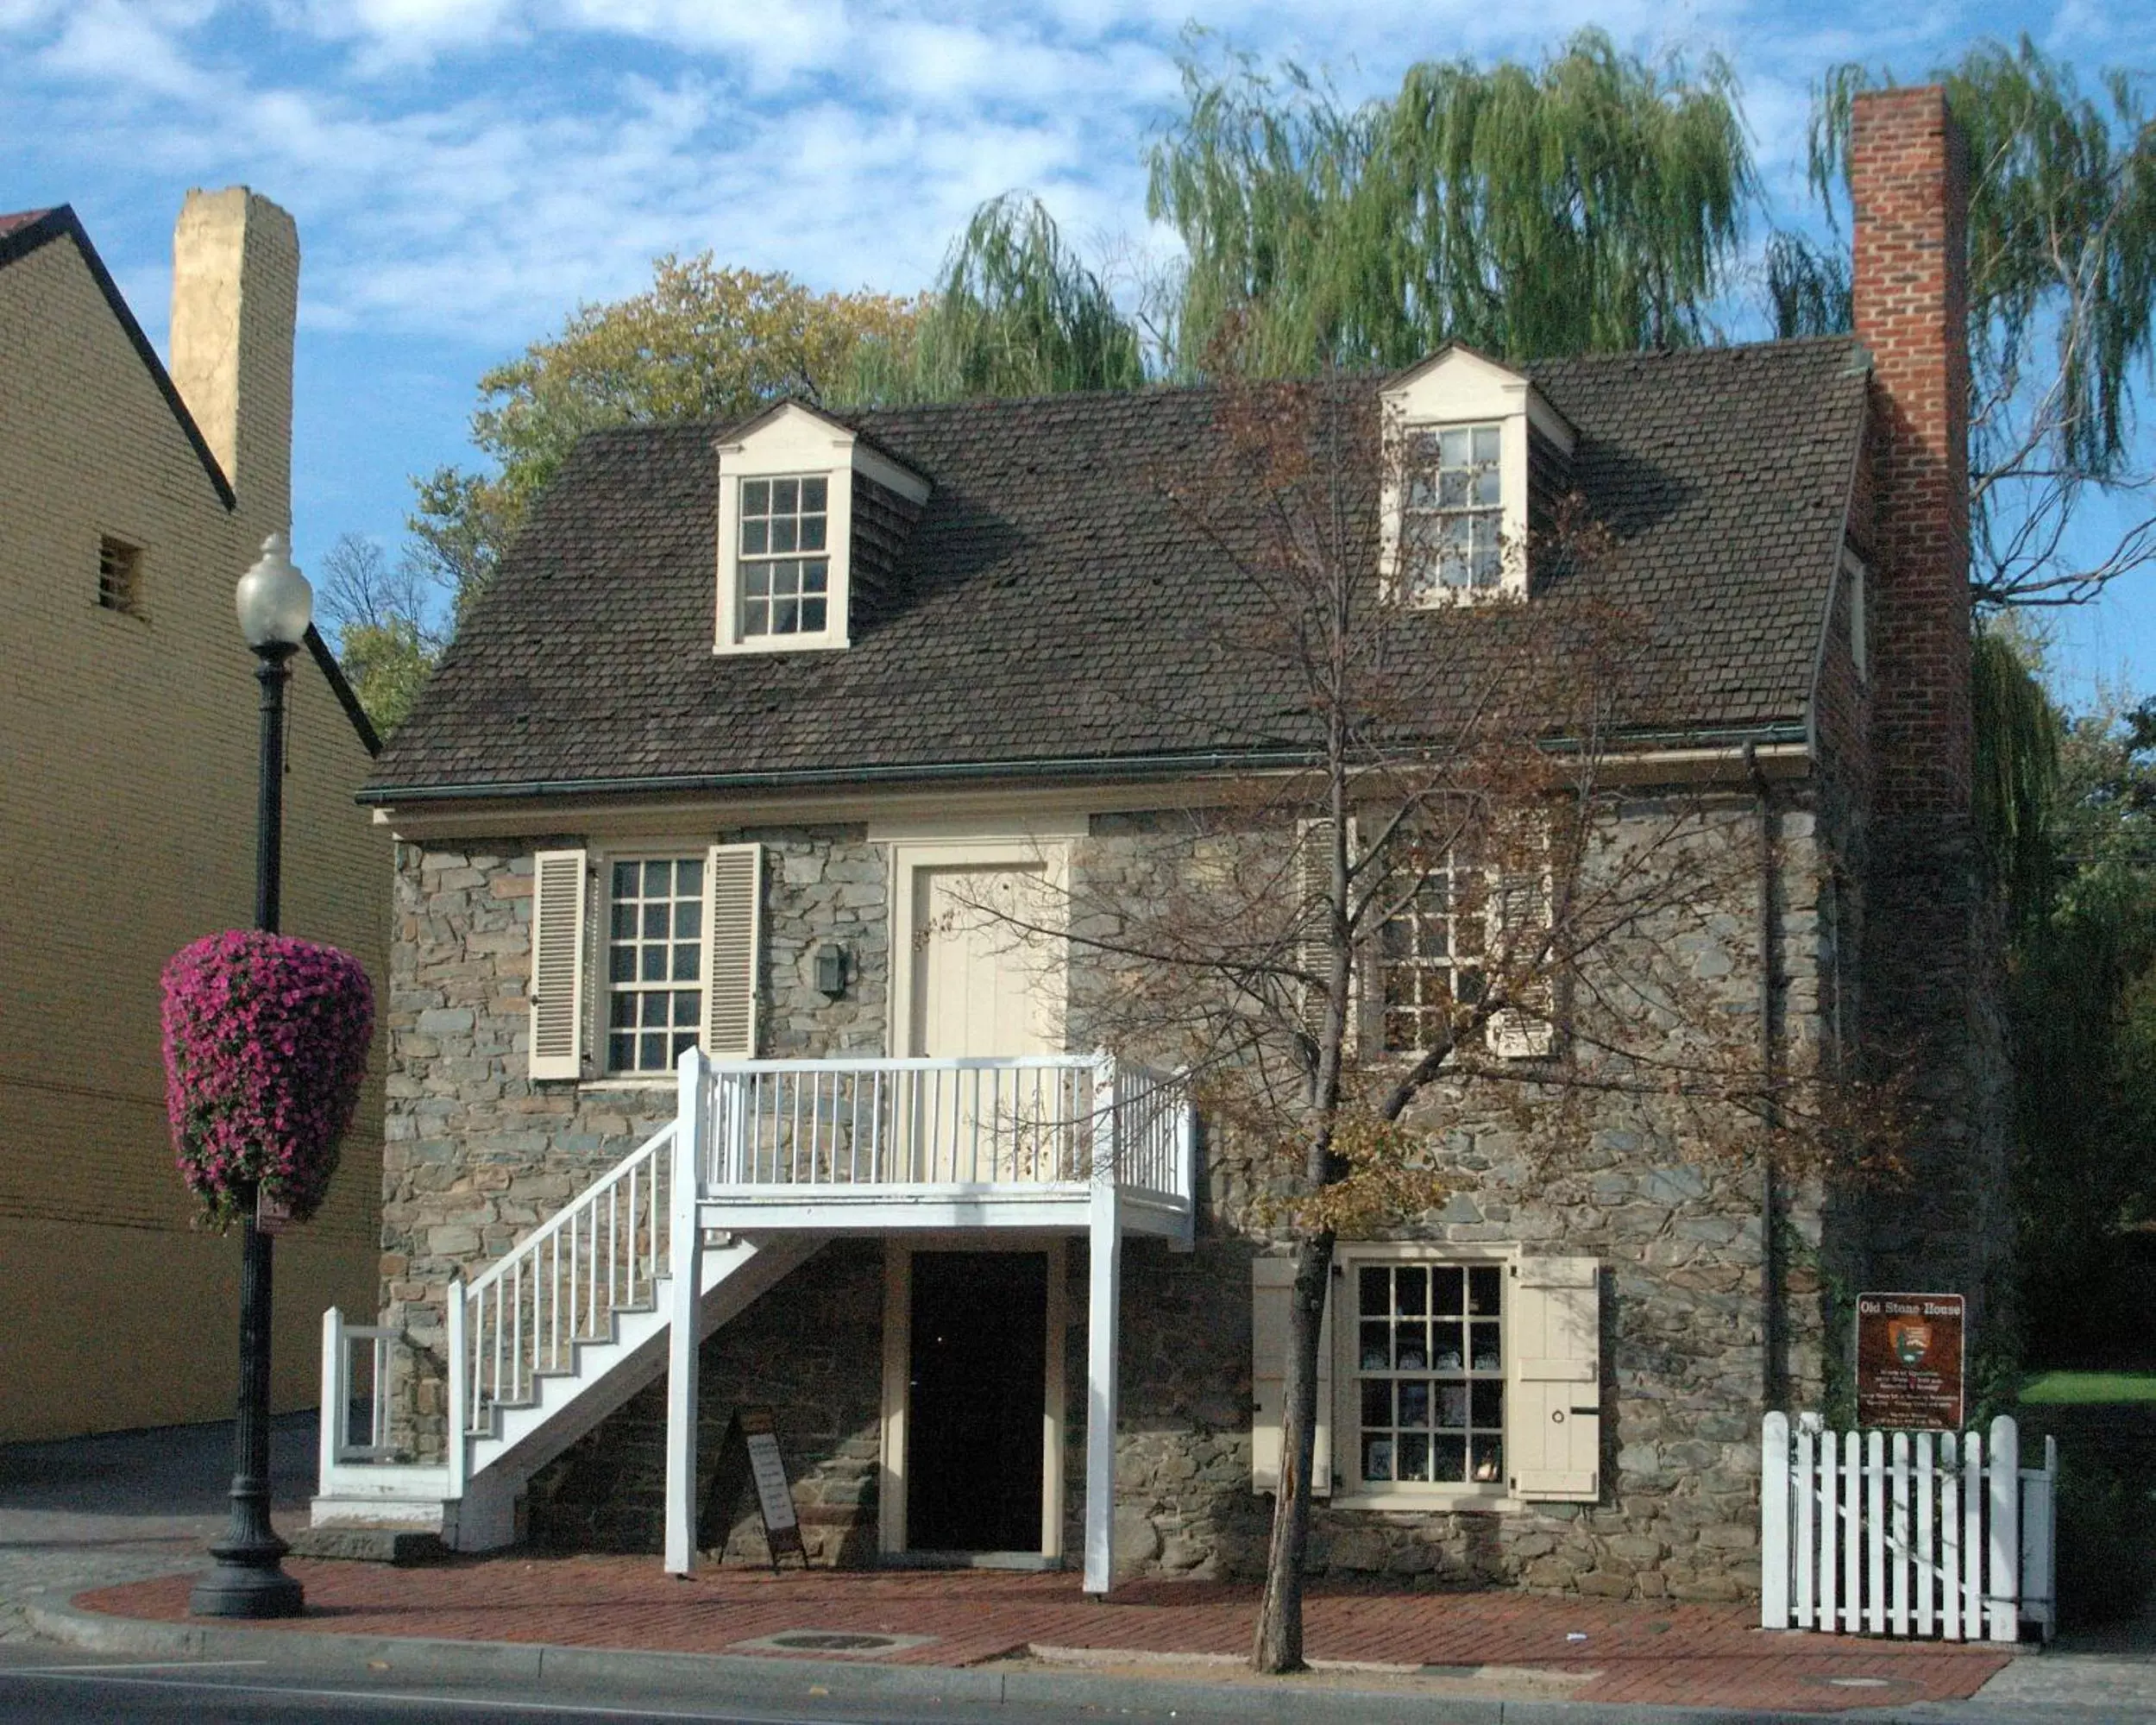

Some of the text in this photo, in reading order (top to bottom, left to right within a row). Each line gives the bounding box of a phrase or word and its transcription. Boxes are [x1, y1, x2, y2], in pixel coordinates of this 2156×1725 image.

[1860, 1301, 1961, 1314] Old Stone House
